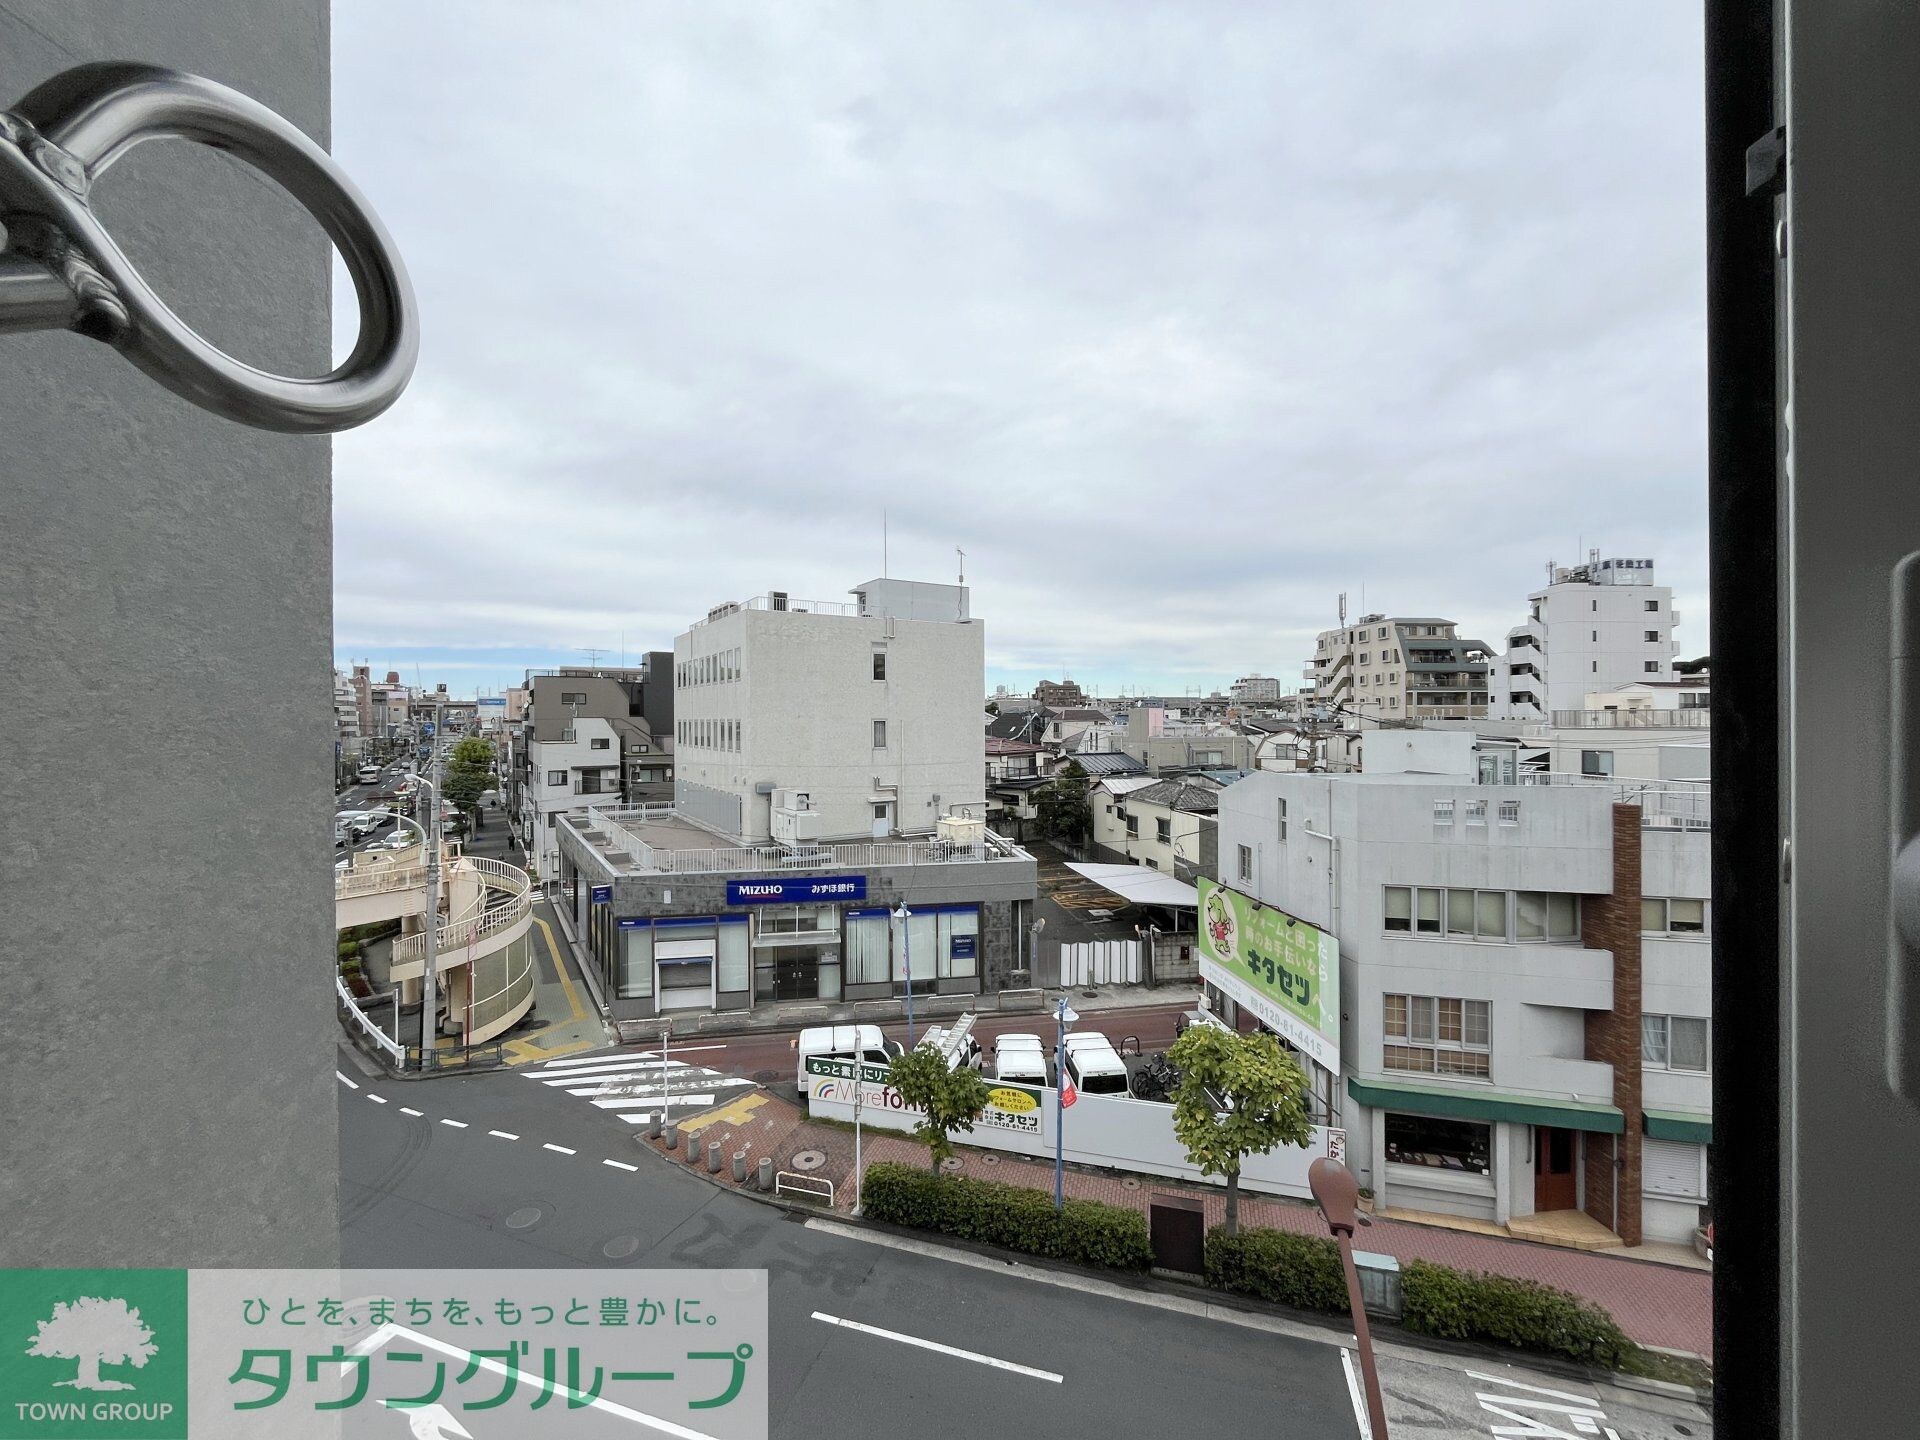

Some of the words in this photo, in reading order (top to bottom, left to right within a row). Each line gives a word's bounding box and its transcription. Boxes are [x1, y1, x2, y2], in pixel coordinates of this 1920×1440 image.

[738, 885, 783, 896] MIZUHO
[811, 883, 855, 894] みずほ銀行
[1247, 948, 1311, 1007] キタセツ
[995, 1112, 1038, 1127] キタセツ
